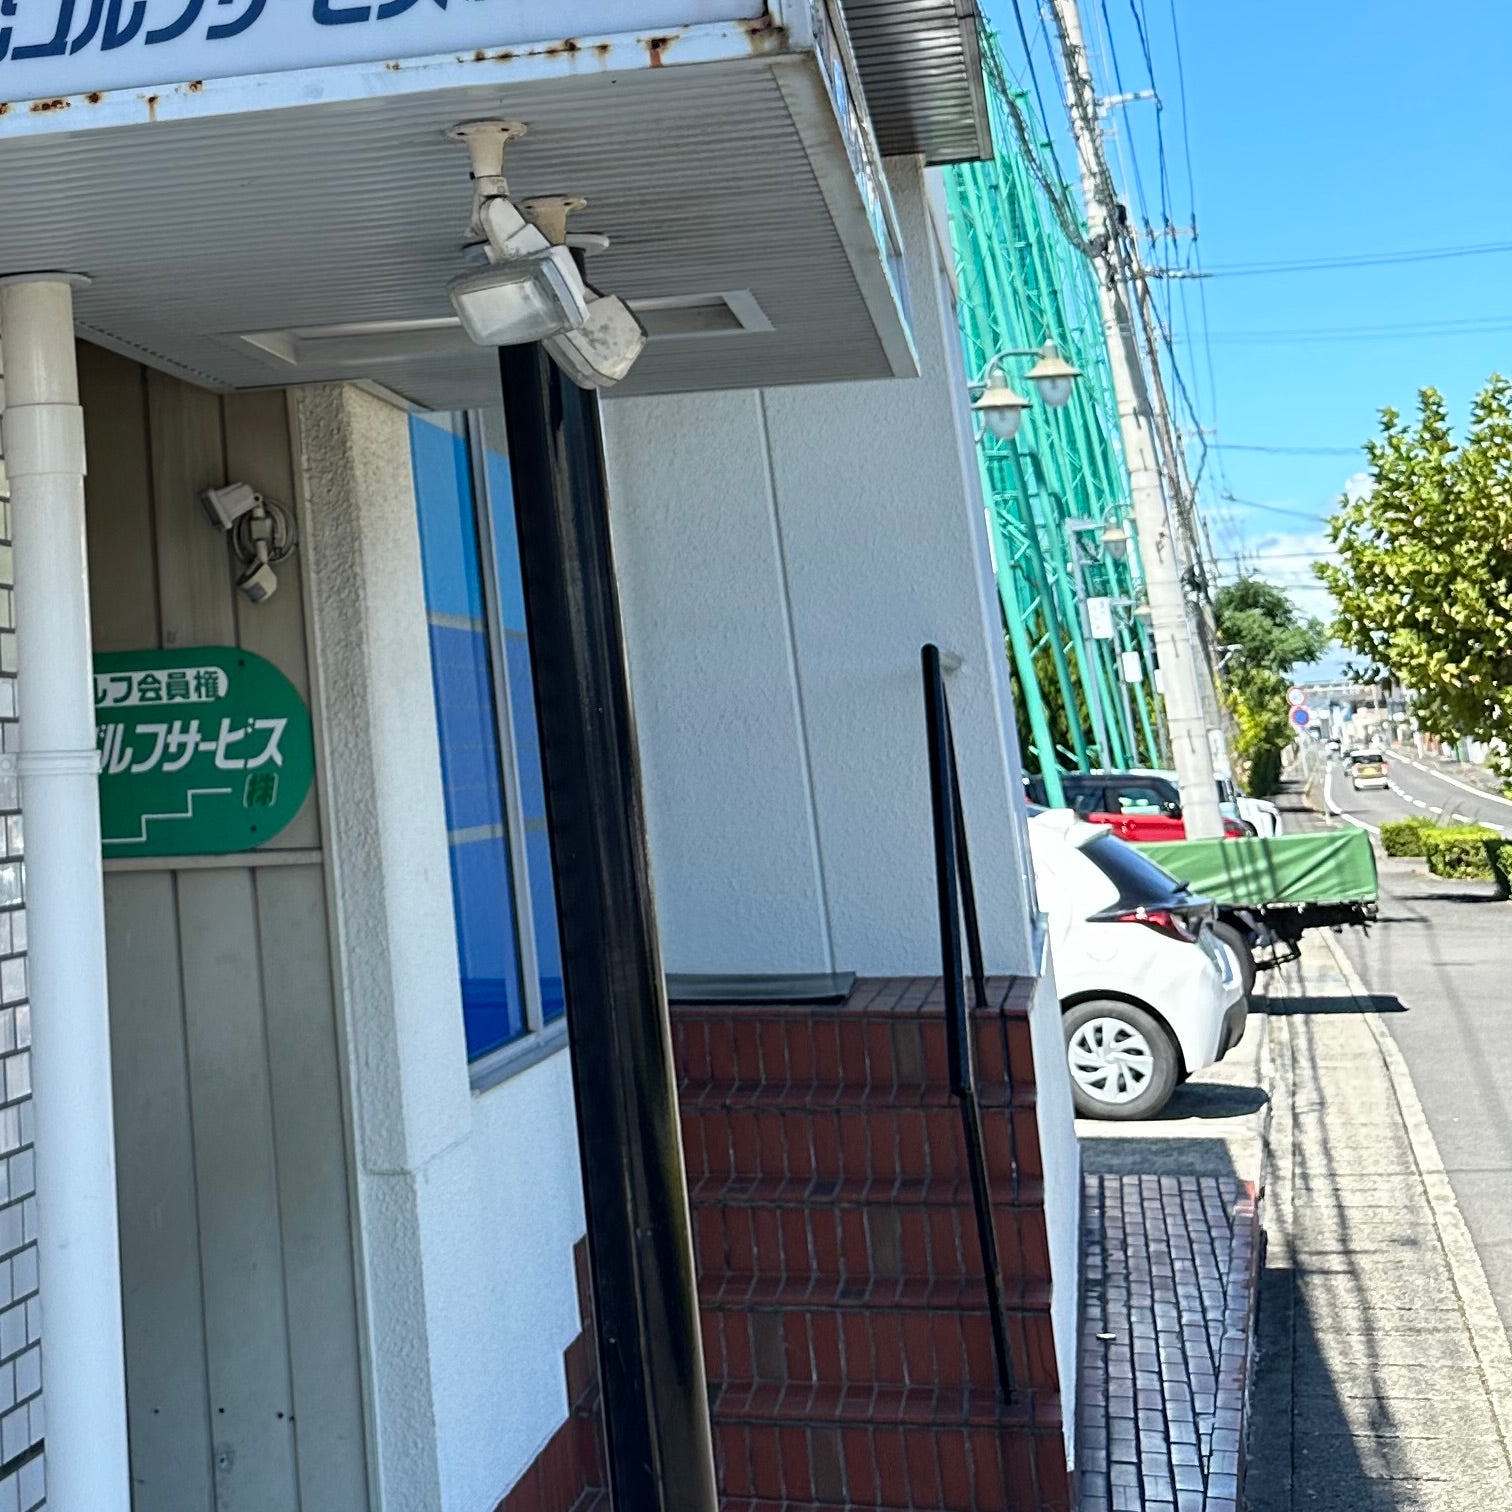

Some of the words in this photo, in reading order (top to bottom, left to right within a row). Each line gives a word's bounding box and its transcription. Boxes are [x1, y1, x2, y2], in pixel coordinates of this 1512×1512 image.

[96, 717, 288, 774] ルフサービス
